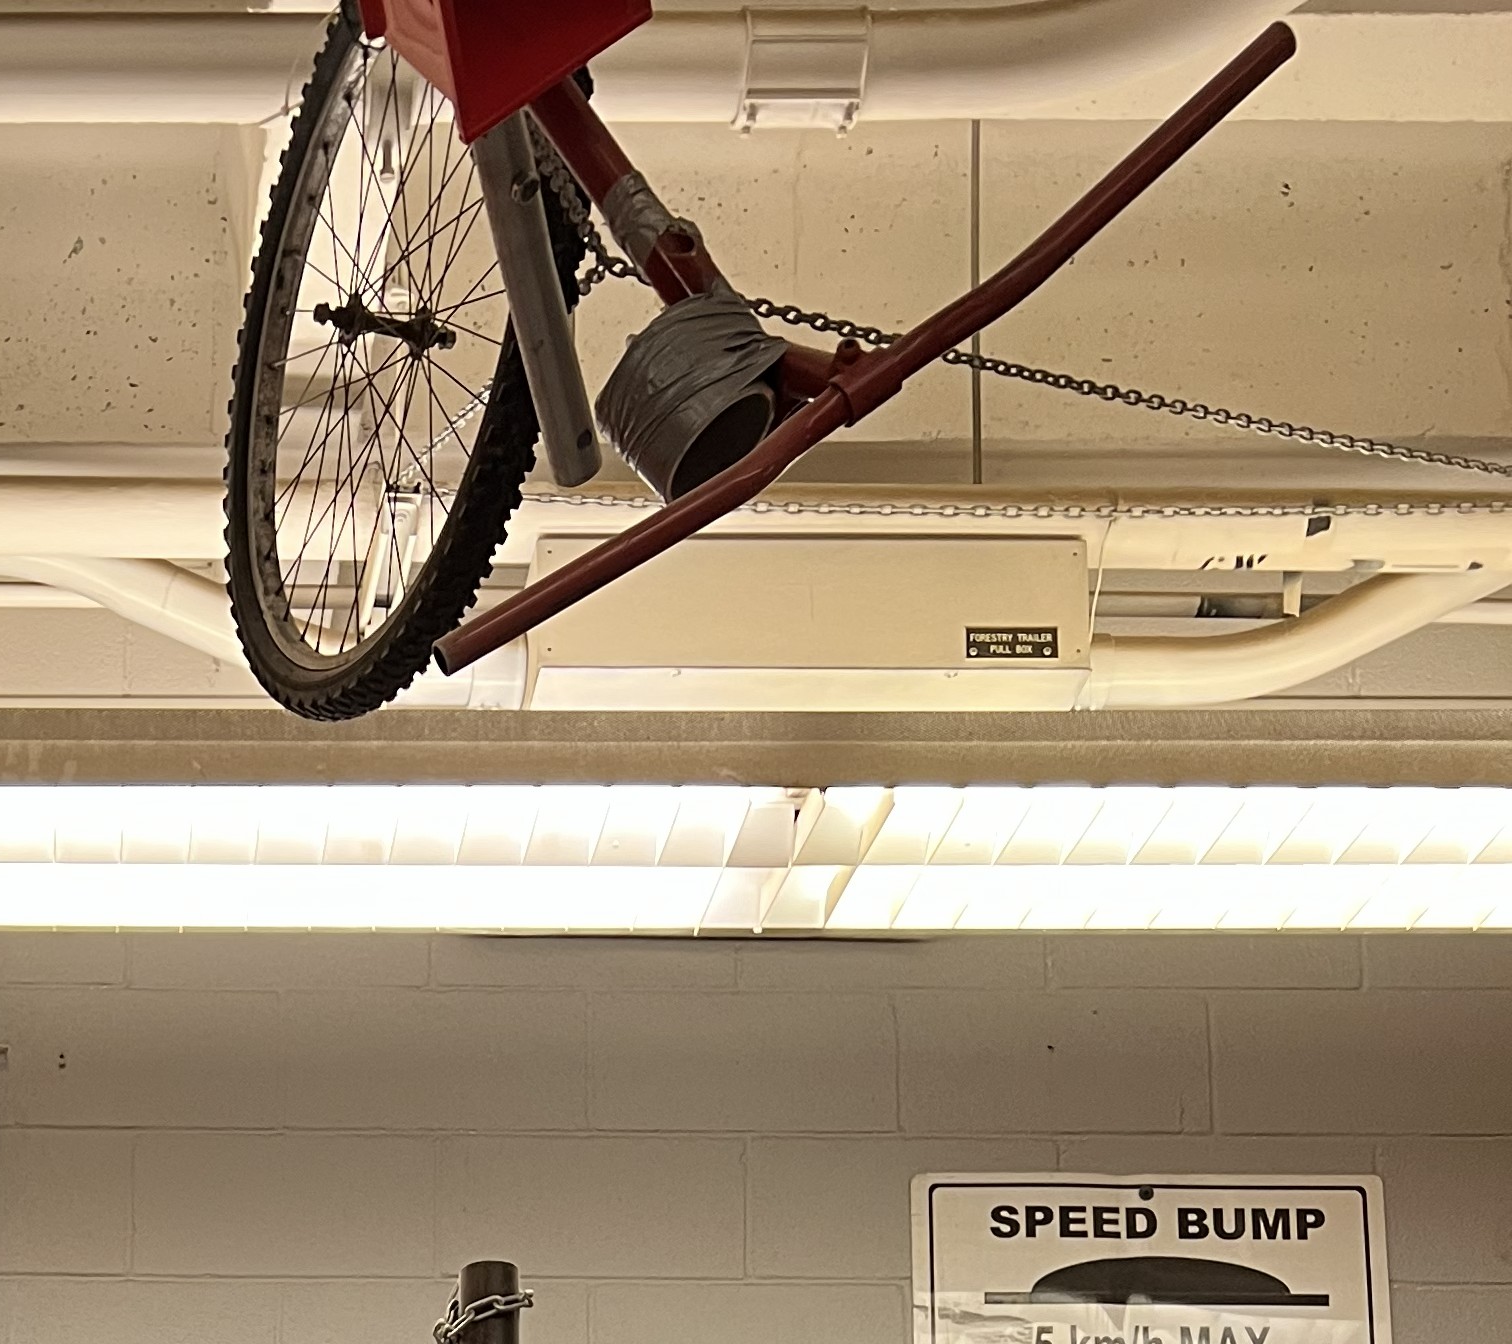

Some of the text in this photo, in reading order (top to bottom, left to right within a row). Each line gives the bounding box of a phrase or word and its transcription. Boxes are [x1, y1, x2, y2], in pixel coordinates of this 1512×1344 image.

[969, 633, 1053, 643] FORESTRY TRAILER
[990, 644, 1033, 654] PULL BOX
[989, 1204, 1326, 1241] SPEED BUMP
